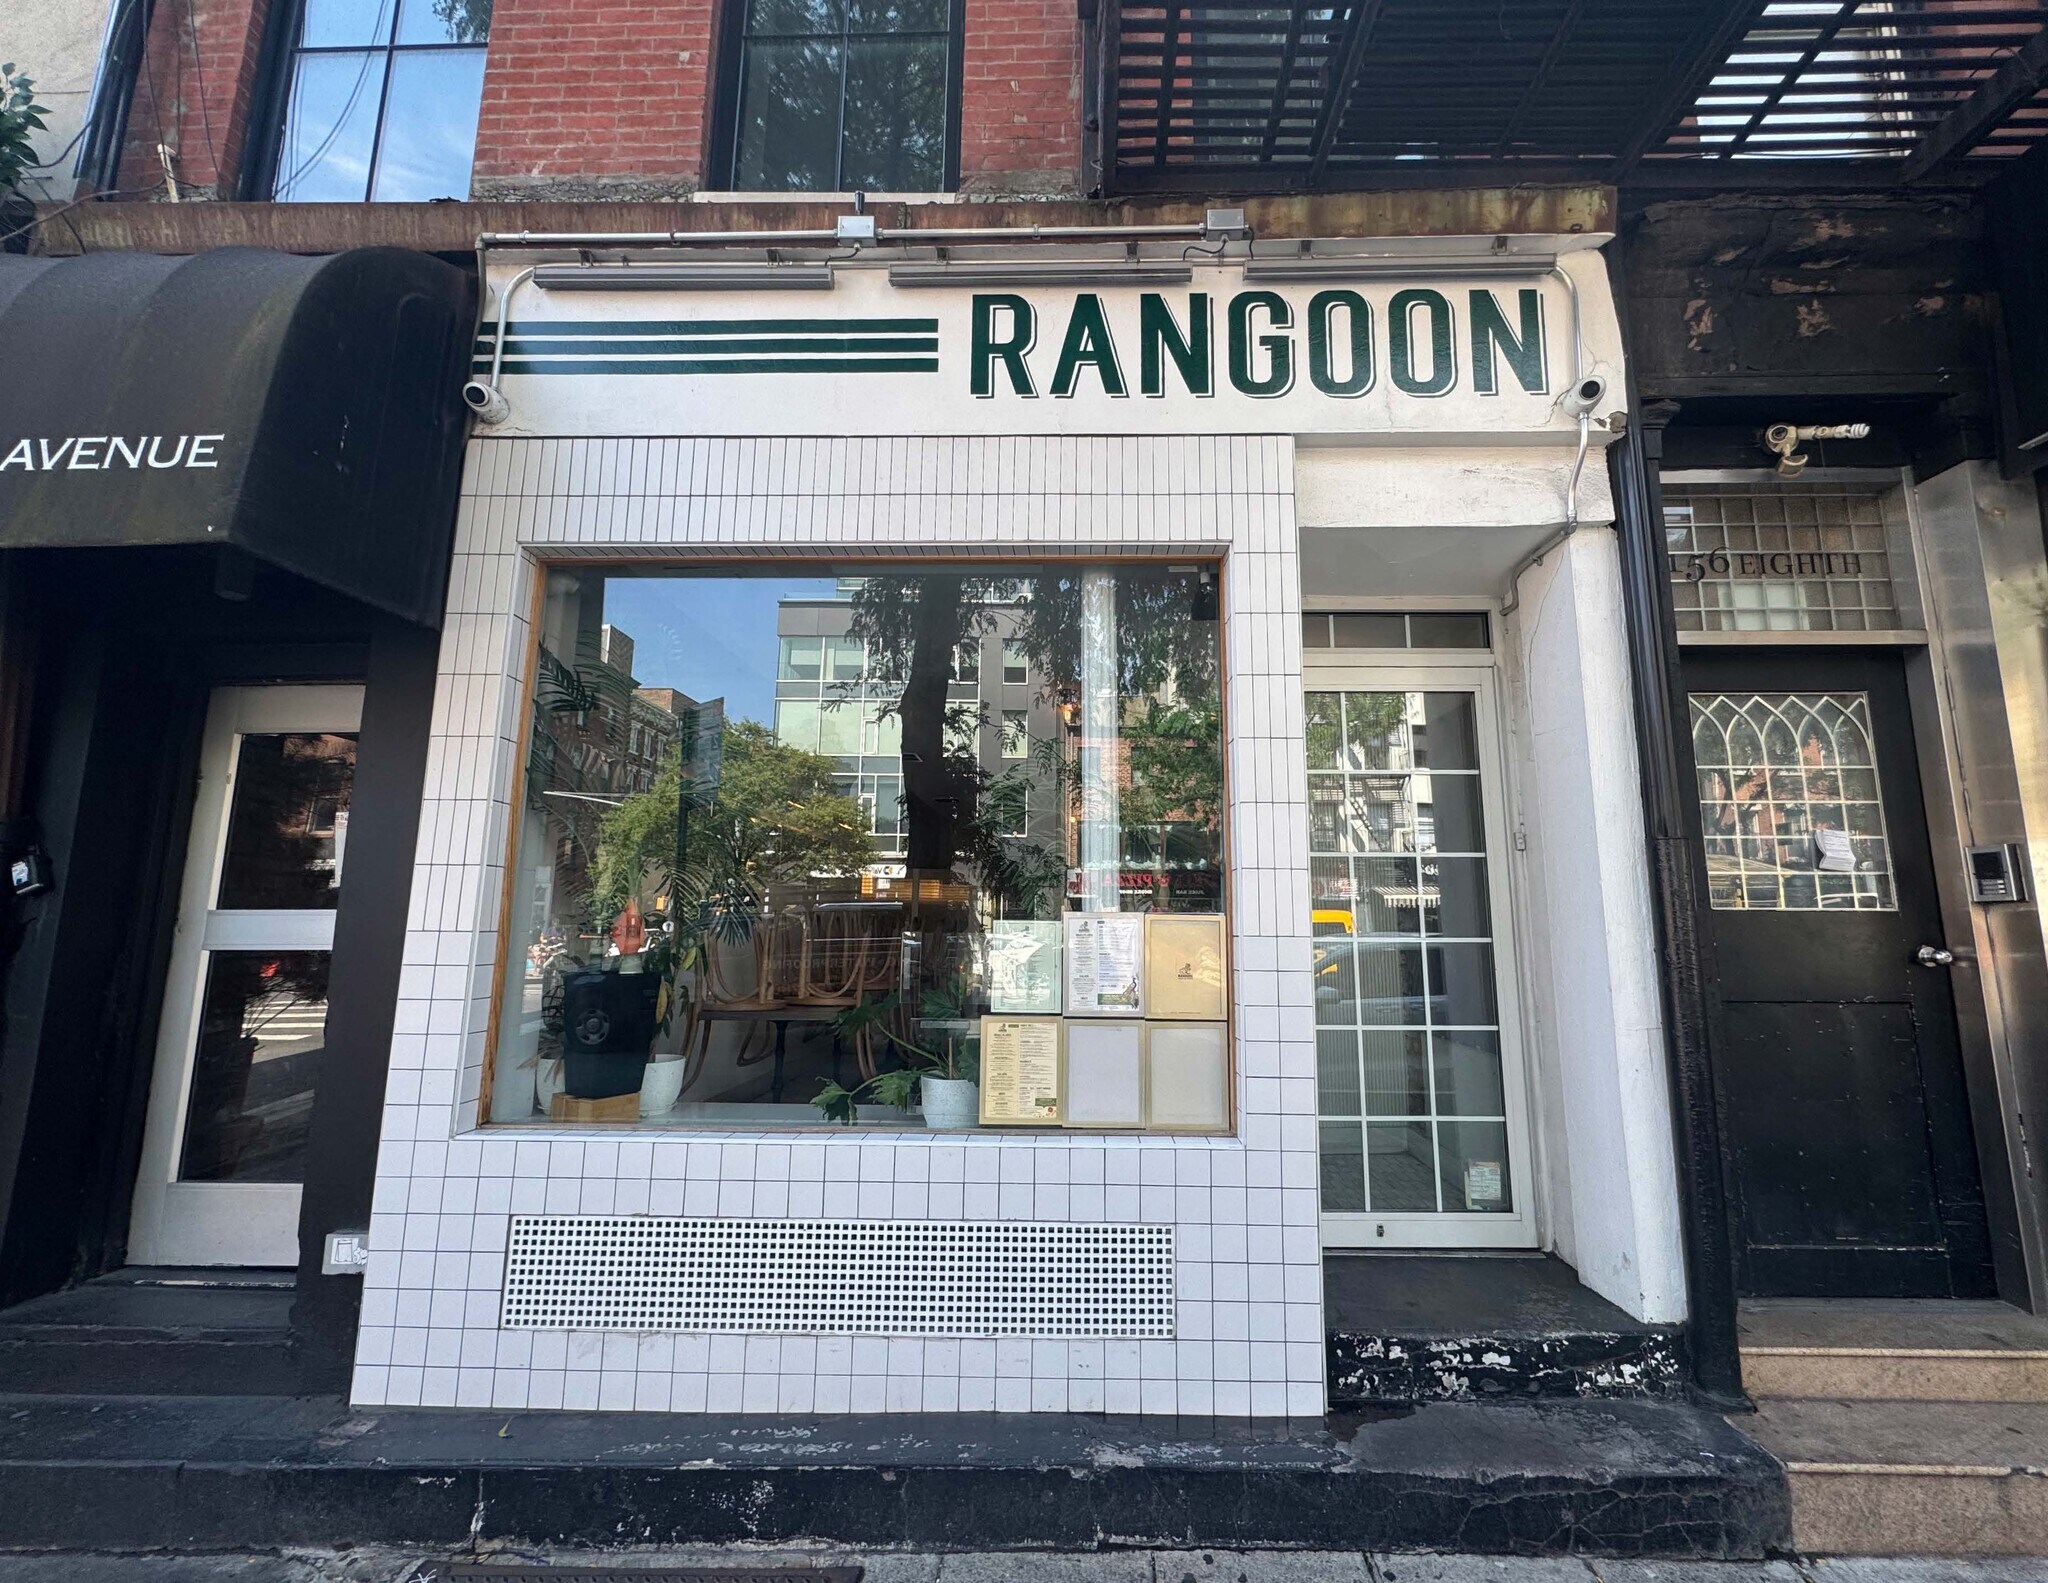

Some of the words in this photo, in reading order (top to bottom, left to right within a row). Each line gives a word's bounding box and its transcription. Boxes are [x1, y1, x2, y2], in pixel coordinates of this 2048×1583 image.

[970, 288, 1548, 399] RANGOON
[0, 434, 225, 471] AVENUE
[1670, 546, 1731, 582] 156
[1739, 552, 1863, 575] EIGHTH
